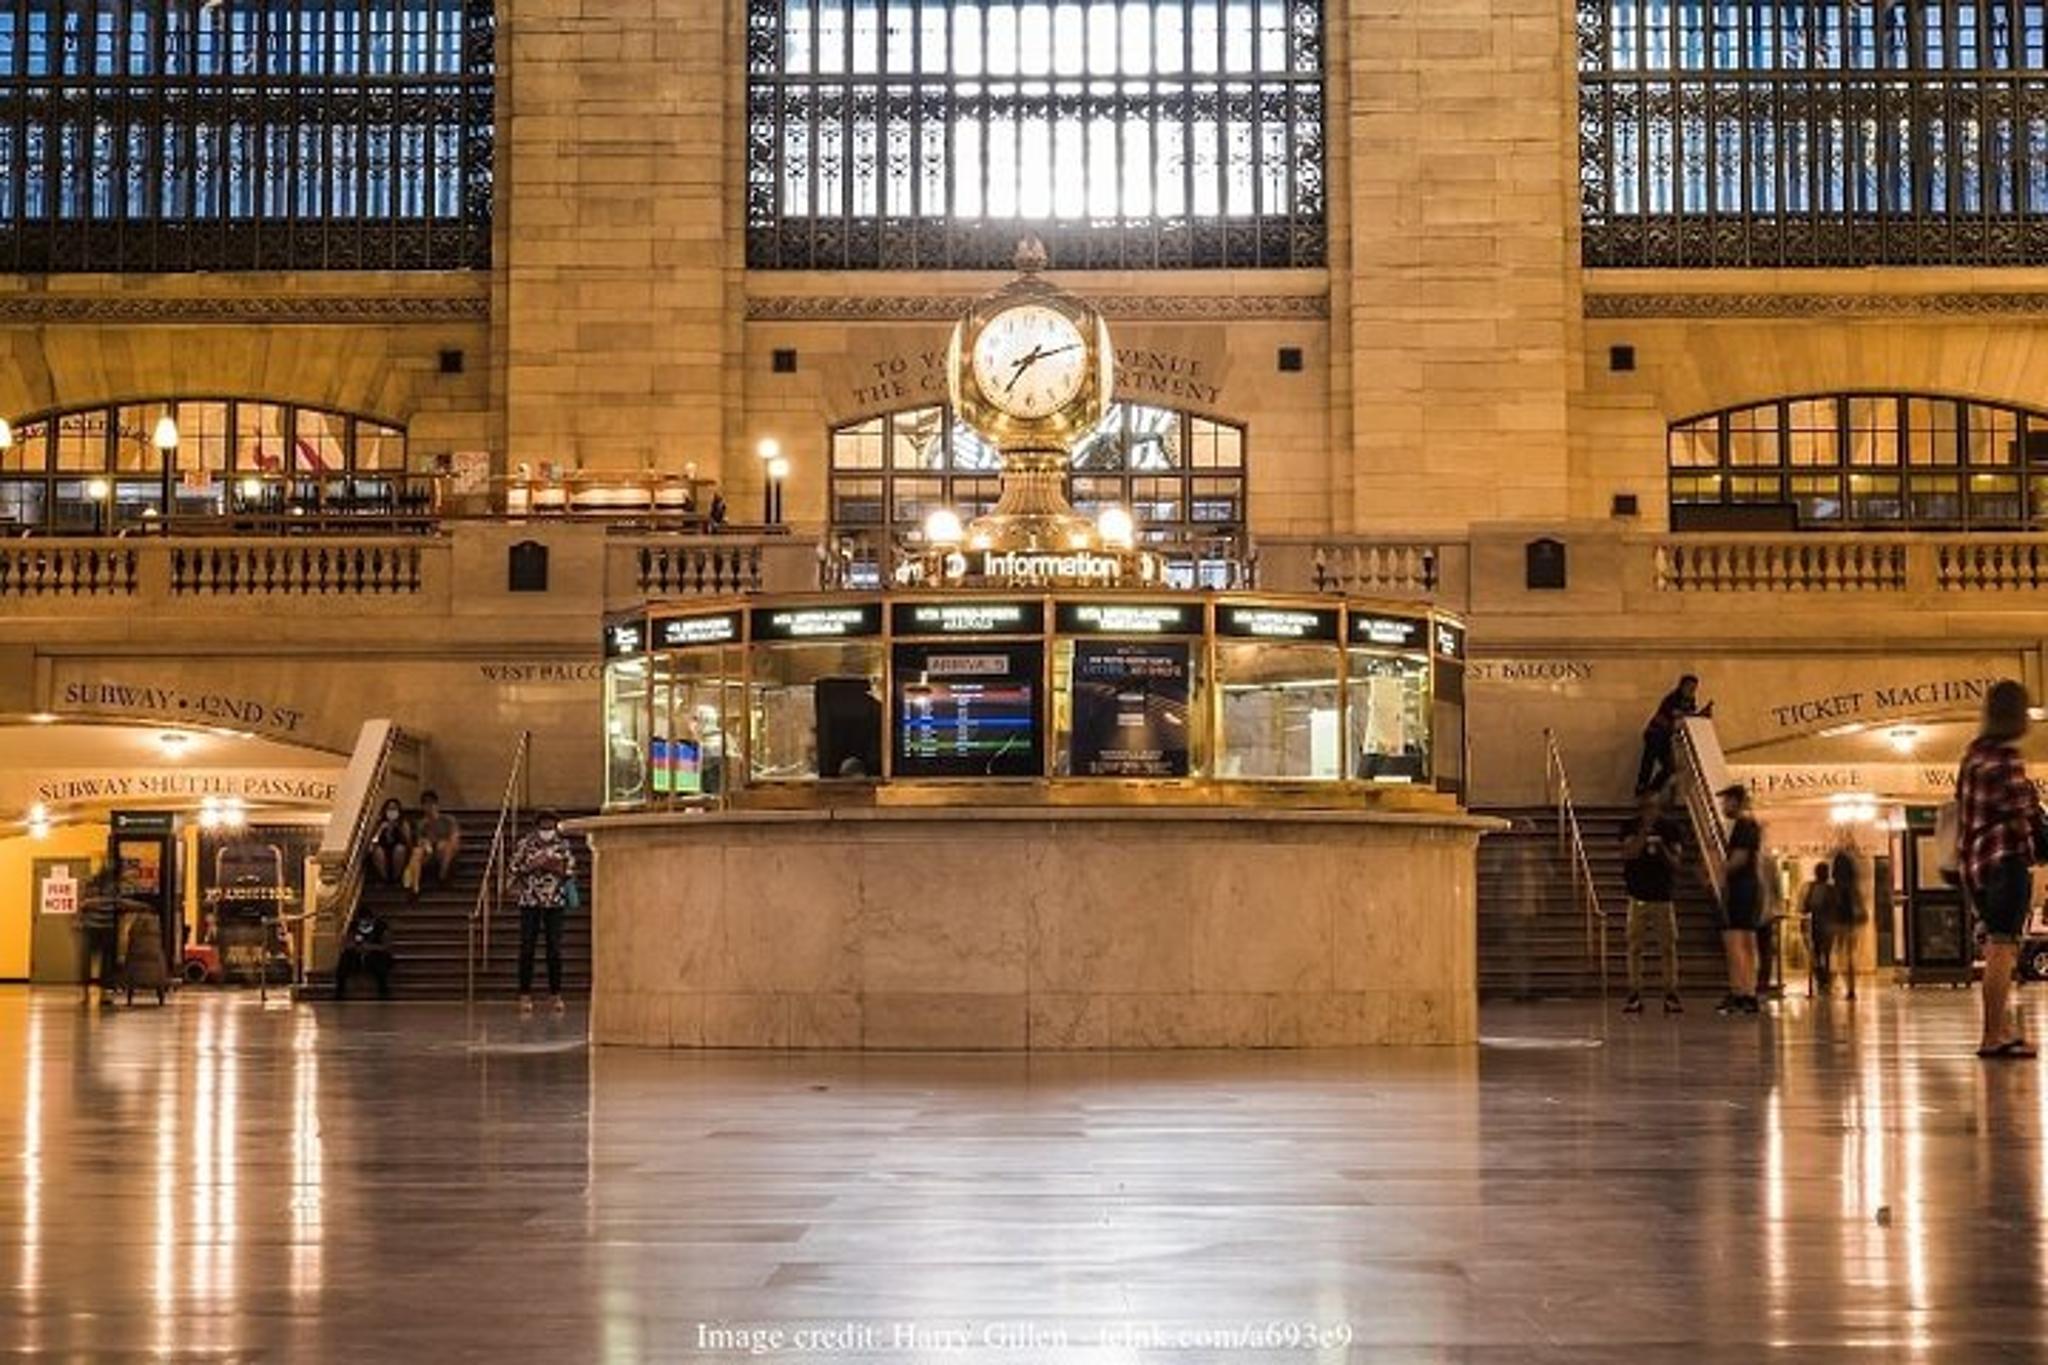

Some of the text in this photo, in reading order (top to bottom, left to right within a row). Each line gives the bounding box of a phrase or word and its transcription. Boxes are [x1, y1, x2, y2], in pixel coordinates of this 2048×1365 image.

[873, 357, 907, 378] TO
[852, 382, 904, 405] THE
[984, 549, 1118, 578] Information
[479, 664, 537, 681] WEST
[932, 658, 1005, 672] ARRIVALS
[1503, 661, 1595, 679] BALCONY
[64, 682, 305, 731] SUBWAY 42ND ST
[1771, 692, 1864, 726] TICKET
[38, 774, 338, 801] SUBWAY SHUTTLE PASSAGE
[1767, 768, 1863, 791] PASSAGE
[45, 898, 74, 910] HOSE
